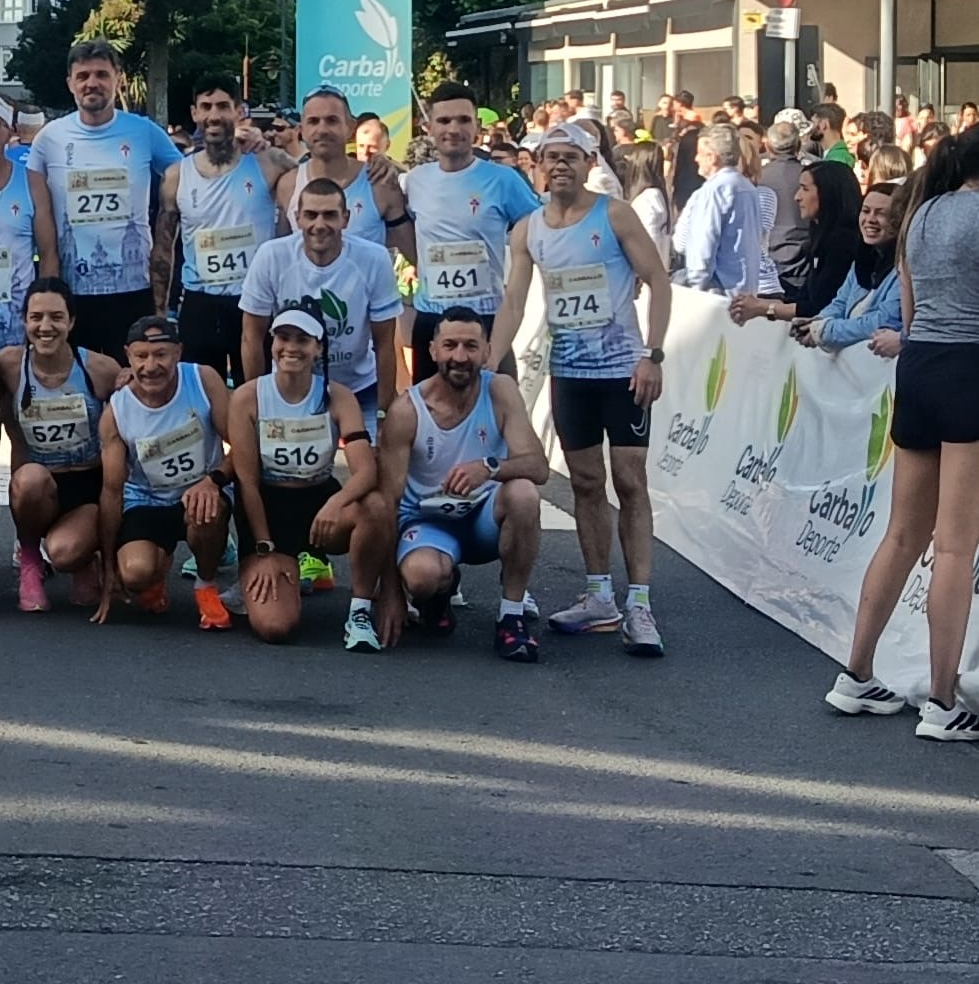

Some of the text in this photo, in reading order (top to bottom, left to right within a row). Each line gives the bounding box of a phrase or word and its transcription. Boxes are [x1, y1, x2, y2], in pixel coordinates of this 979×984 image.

[318, 52, 405, 81] Carballo
[320, 80, 383, 97] porte
[77, 193, 120, 214] 273
[207, 250, 249, 273] 541
[437, 268, 478, 289] 461
[555, 294, 600, 318] 274
[32, 422, 76, 443] 527
[668, 412, 713, 457] Carballo
[161, 451, 195, 478] 35
[274, 445, 319, 466] 516
[809, 480, 876, 540] Carballo
[796, 519, 841, 563] Deporte
